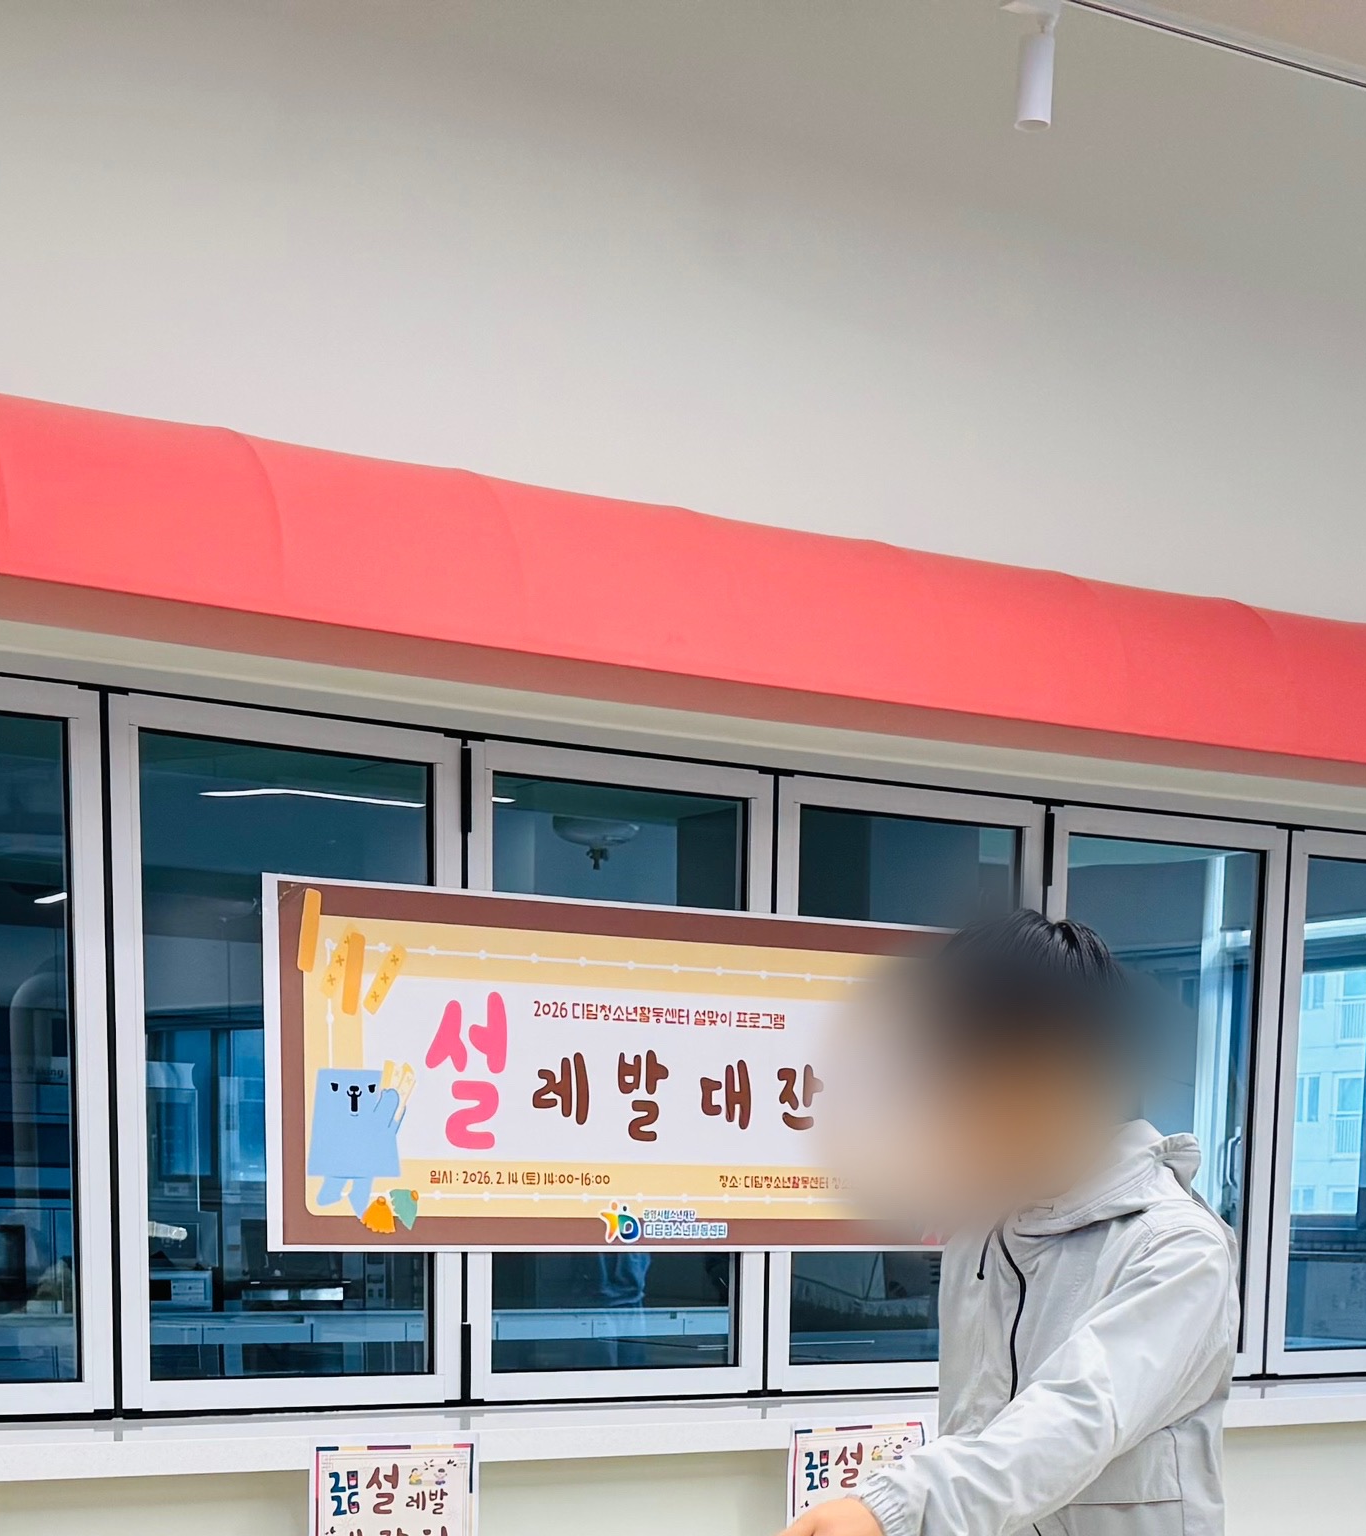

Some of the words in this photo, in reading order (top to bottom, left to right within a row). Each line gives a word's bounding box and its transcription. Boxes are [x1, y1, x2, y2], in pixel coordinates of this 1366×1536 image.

[533, 1000, 568, 1019] 2026
[571, 1002, 690, 1025] 디딤청소년활동센터
[693, 1008, 732, 1027] 설맞이
[735, 1011, 786, 1030] 프로그램
[430, 1170, 452, 1184] 일시
[462, 1171, 493, 1185] 2026.
[508, 1172, 519, 1185] 14
[521, 1172, 541, 1186] (토)
[544, 1172, 611, 1187] 14:00-16:00
